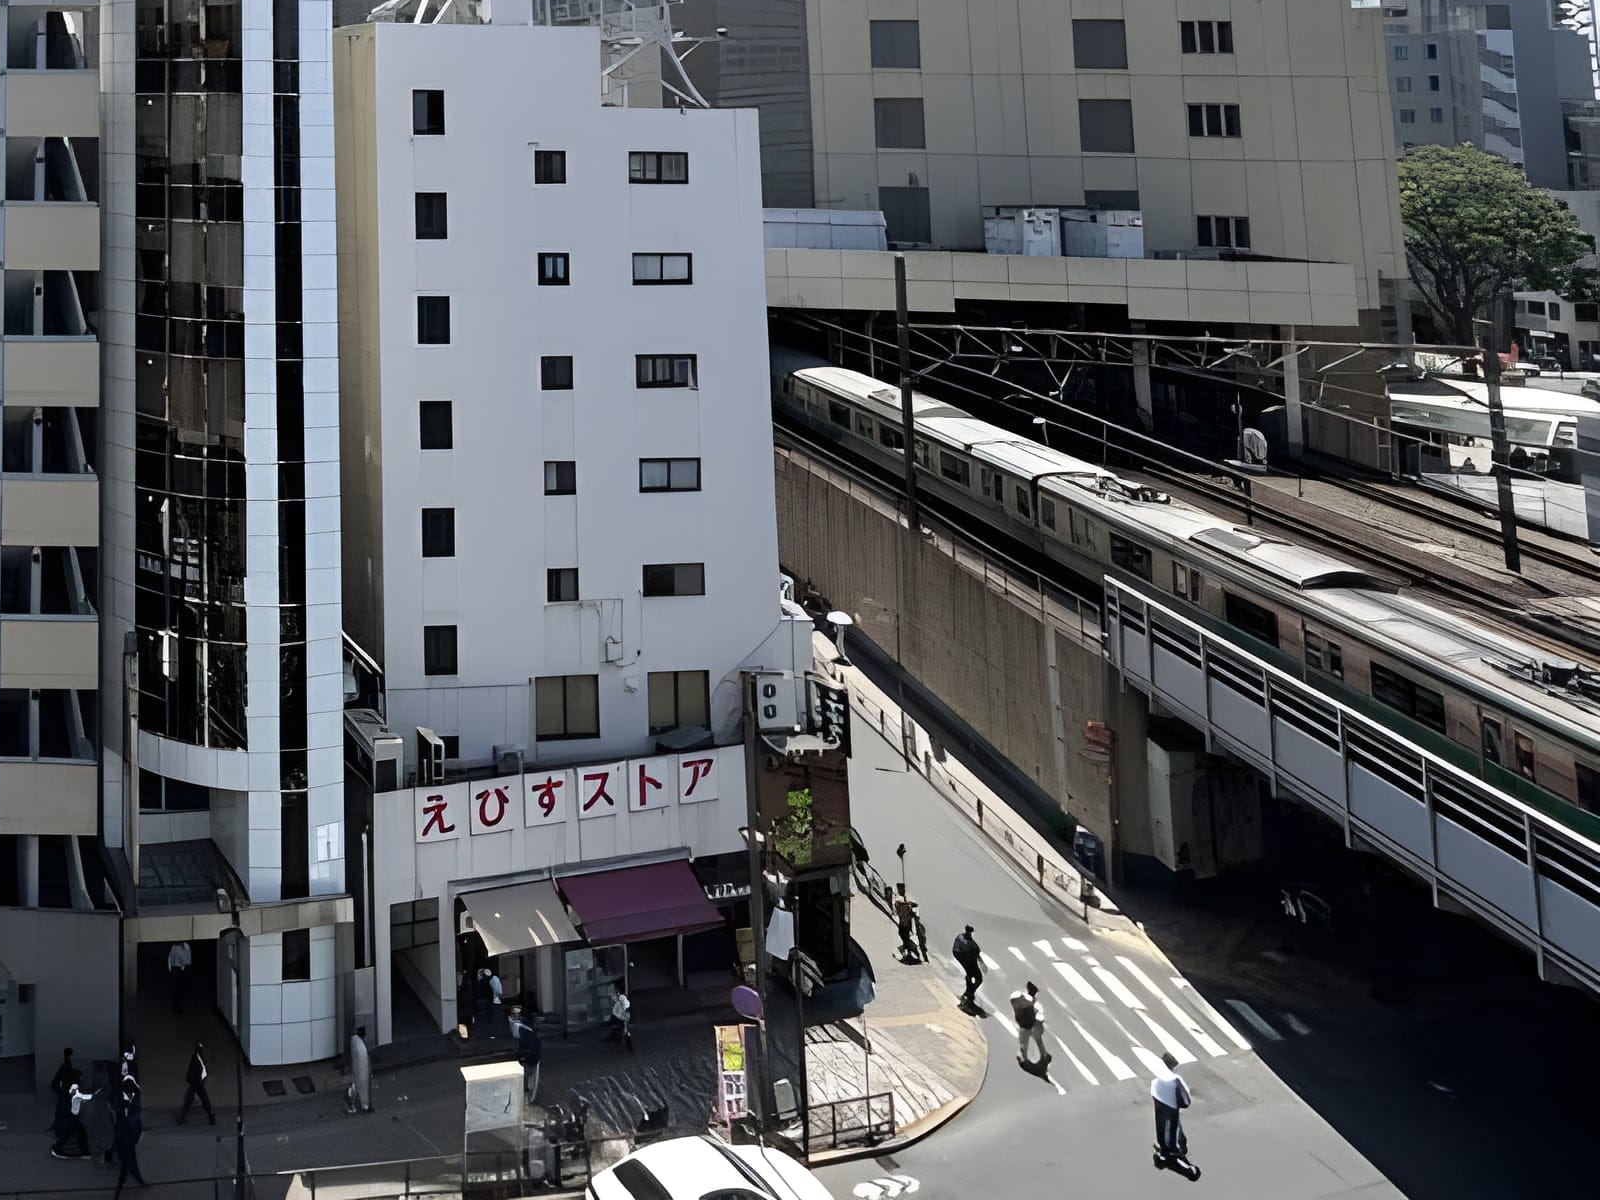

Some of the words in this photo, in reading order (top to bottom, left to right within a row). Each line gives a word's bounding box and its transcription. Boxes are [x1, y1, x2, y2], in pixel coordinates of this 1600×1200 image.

[421, 758, 714, 836] えびすストア
